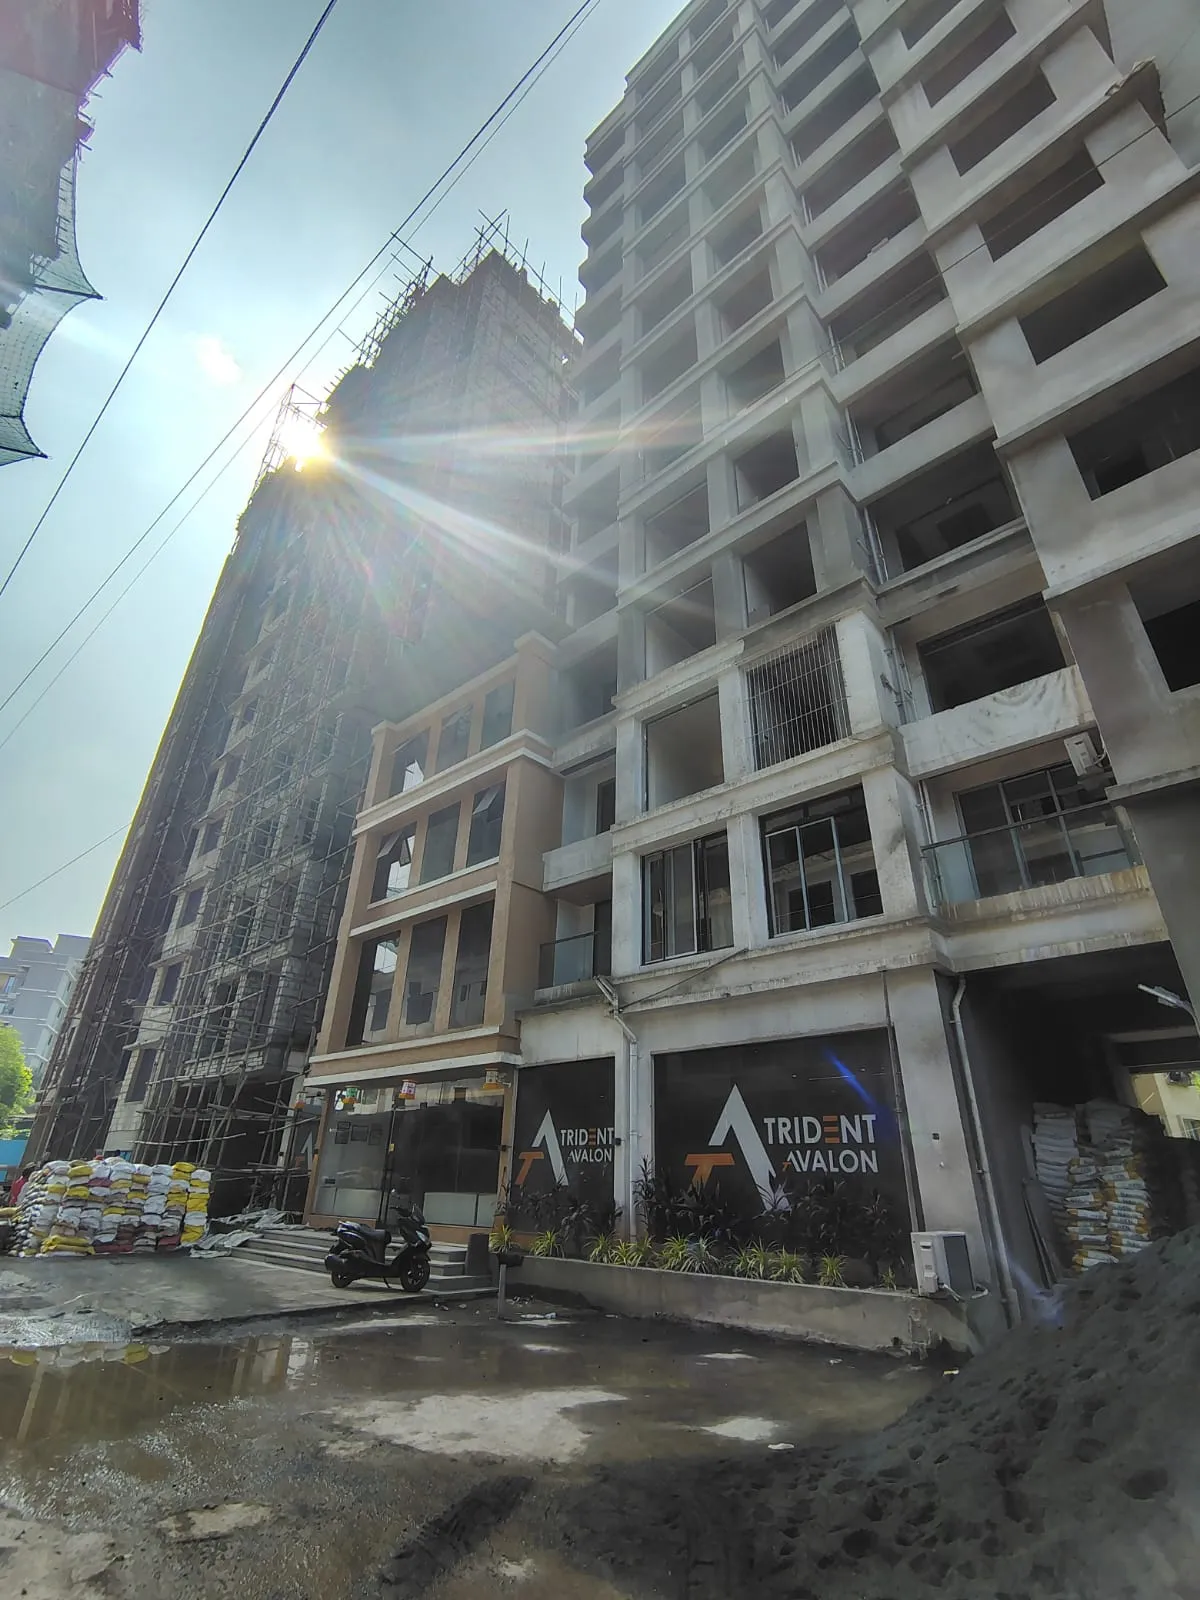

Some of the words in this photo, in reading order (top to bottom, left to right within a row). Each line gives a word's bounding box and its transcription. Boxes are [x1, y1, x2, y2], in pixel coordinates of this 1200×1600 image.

[560, 1127, 614, 1147] TRIDENT
[763, 1114, 877, 1145] TRIDENT
[567, 1148, 612, 1163] AVALON
[782, 1149, 879, 1173] AVALON
